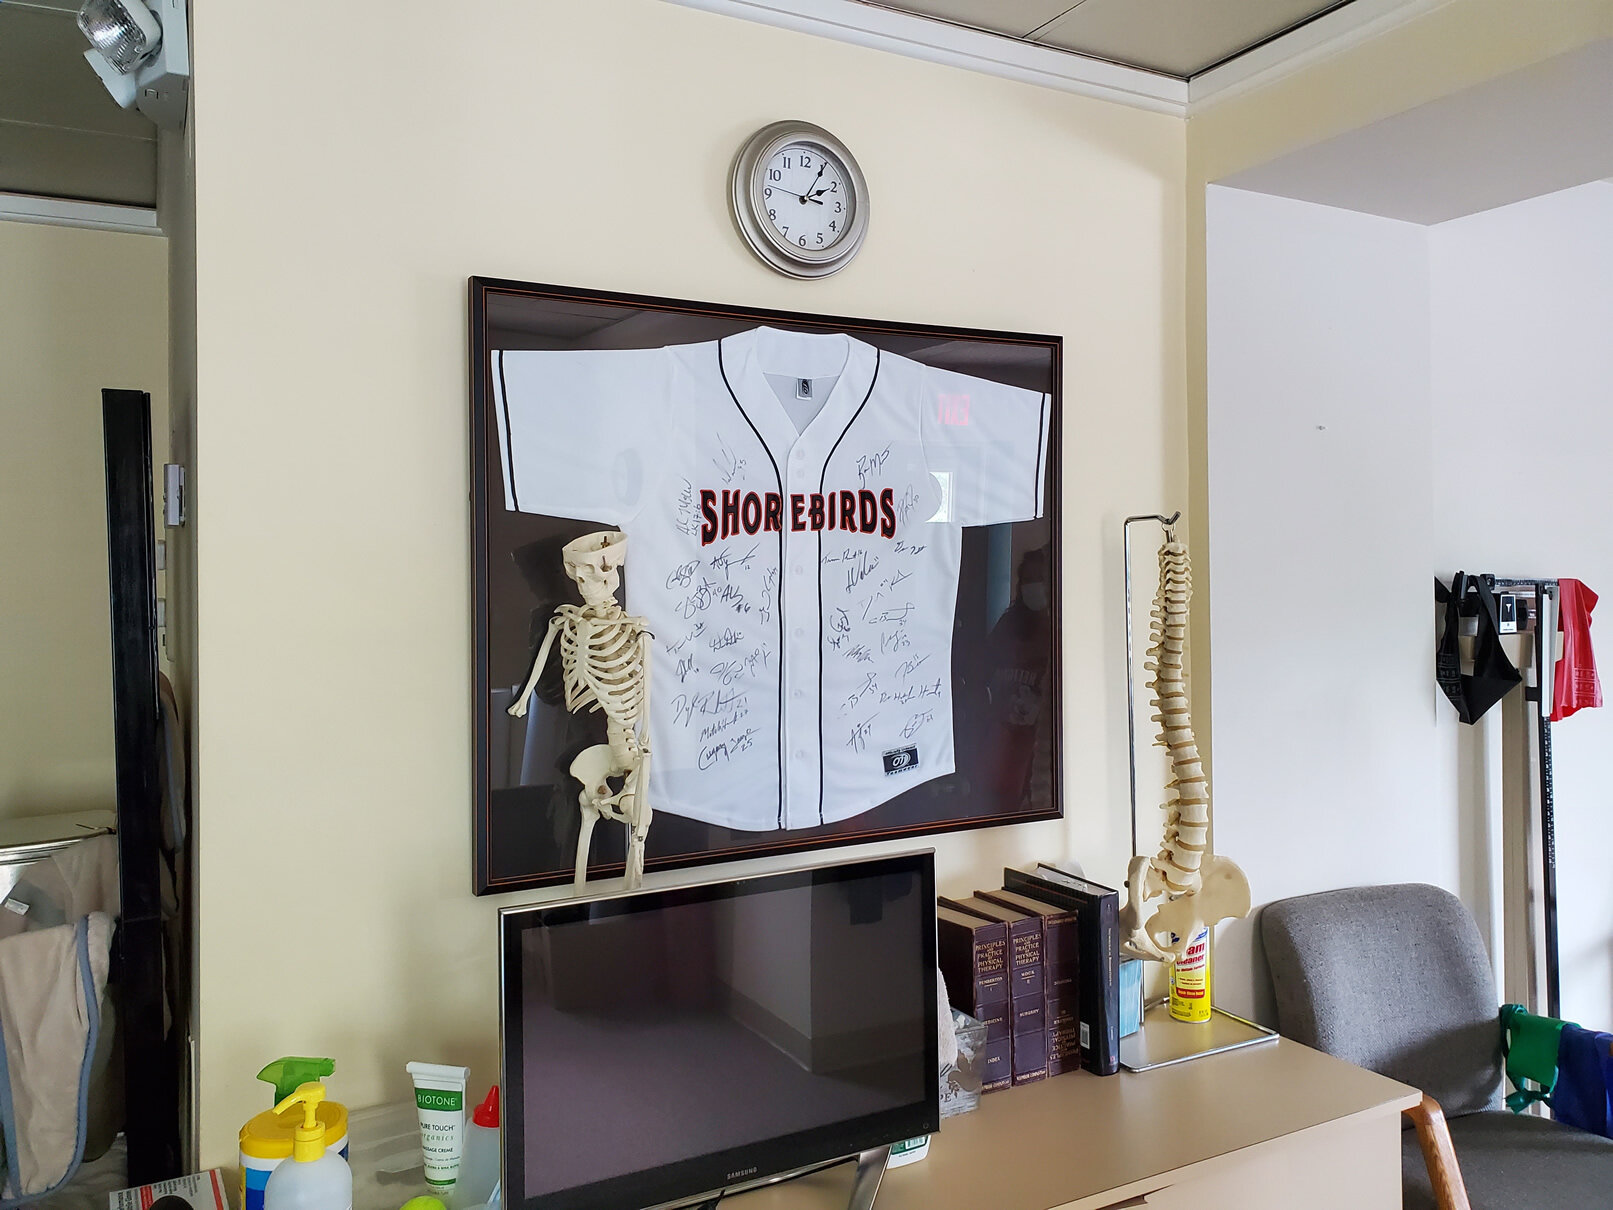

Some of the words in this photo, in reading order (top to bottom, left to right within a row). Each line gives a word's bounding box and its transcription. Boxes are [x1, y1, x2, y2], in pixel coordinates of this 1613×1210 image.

[783, 156, 791, 169] 11
[800, 155, 811, 168] 12
[769, 168, 782, 182] 10
[830, 181, 838, 193] 2
[764, 188, 772, 200] 9
[834, 201, 842, 214] 3
[769, 209, 777, 221] 8
[782, 226, 790, 238] 7
[828, 220, 837, 232] 4
[798, 234, 806, 246] 6
[816, 233, 824, 244] 5
[700, 488, 896, 546] SHOREBIRDS
[976, 940, 1006, 951] PRINCIPLES
[1013, 934, 1041, 945] PRINCIPLES
[1016, 942, 1040, 952] PRACTICE
[1186, 943, 1205, 956] am
[978, 949, 1003, 959] PRACTICE
[1016, 950, 1040, 960] PHYSICAL
[978, 958, 1004, 968] PHYSICAL
[1016, 956, 1040, 966] THERAPY
[978, 964, 1002, 973] THERAPY
[418, 1094, 456, 1106] BIOTONE
[421, 1133, 454, 1141] rganics
[727, 1166, 758, 1180] SAMSUNG
